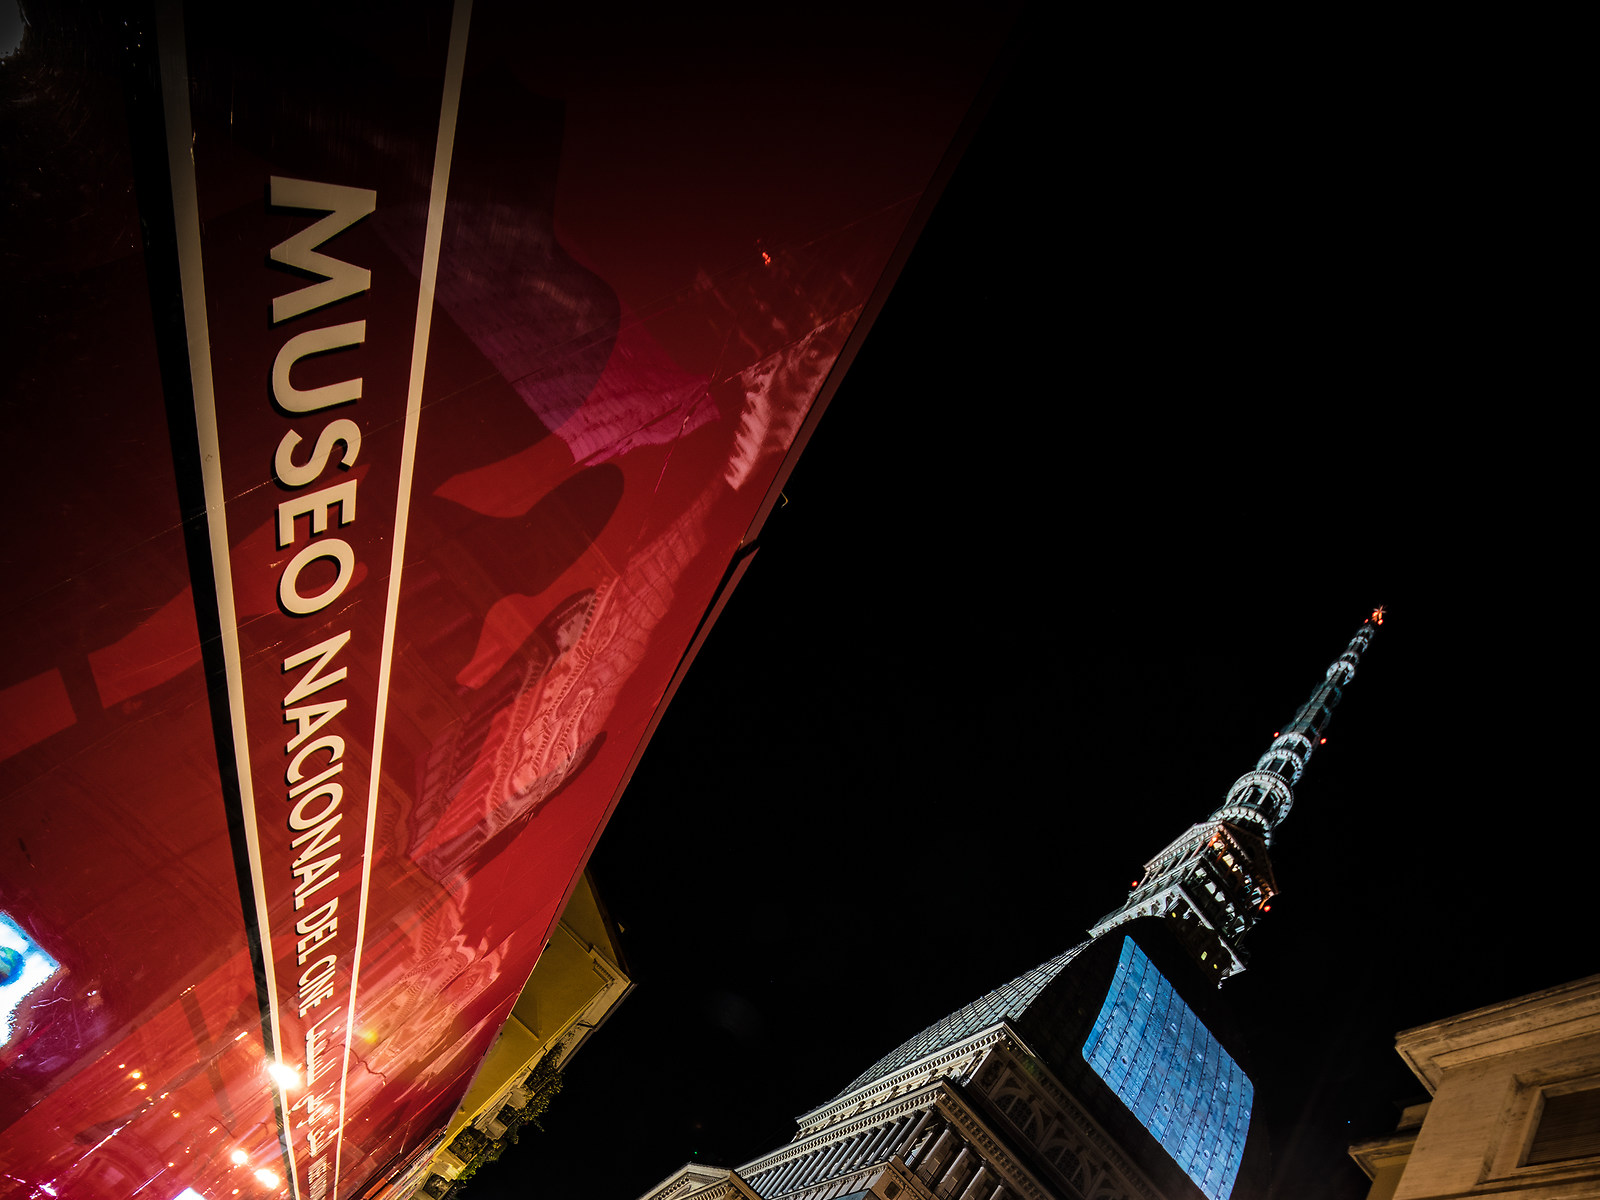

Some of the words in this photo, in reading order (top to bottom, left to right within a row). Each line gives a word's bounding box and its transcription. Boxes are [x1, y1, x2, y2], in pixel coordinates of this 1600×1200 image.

[269, 174, 377, 616] MUSEO
[282, 630, 352, 911] NACIONAL
[296, 896, 339, 966] DEL
[299, 954, 338, 1018] CINE
[296, 1006, 341, 1087] للسينما
